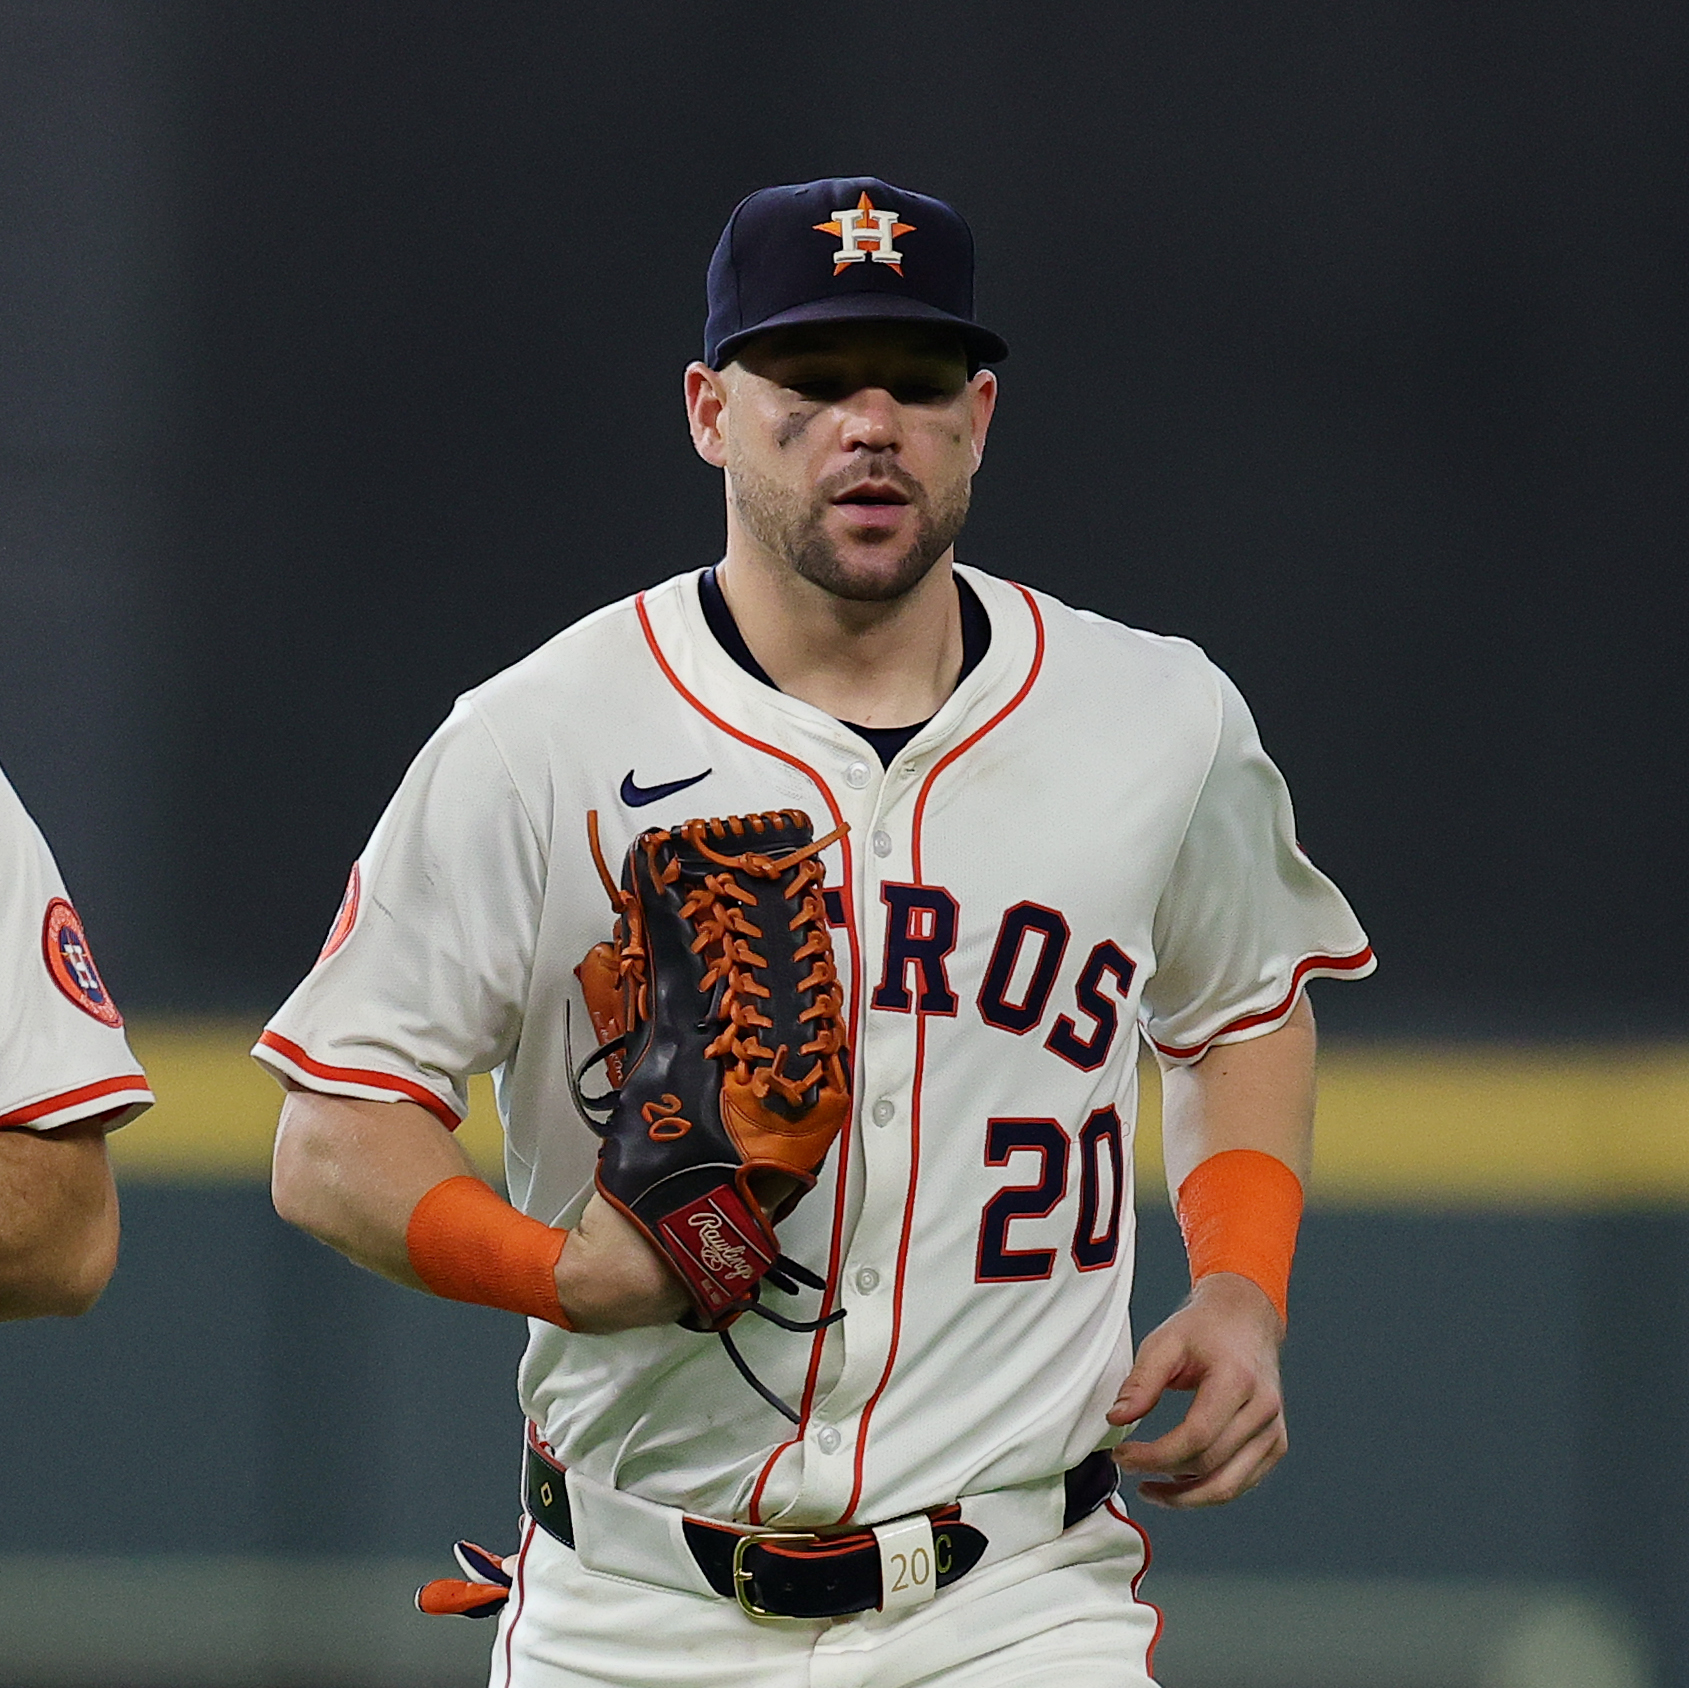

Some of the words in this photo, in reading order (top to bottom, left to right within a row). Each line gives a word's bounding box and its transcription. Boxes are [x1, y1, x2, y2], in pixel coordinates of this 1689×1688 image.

[831, 208, 904, 265] H
[823, 880, 1137, 1073] ROS
[641, 1093, 693, 1142] 20
[974, 1102, 1124, 1284] 20
[687, 1212, 755, 1280] Rawlings
[890, 1547, 930, 1593] 20
